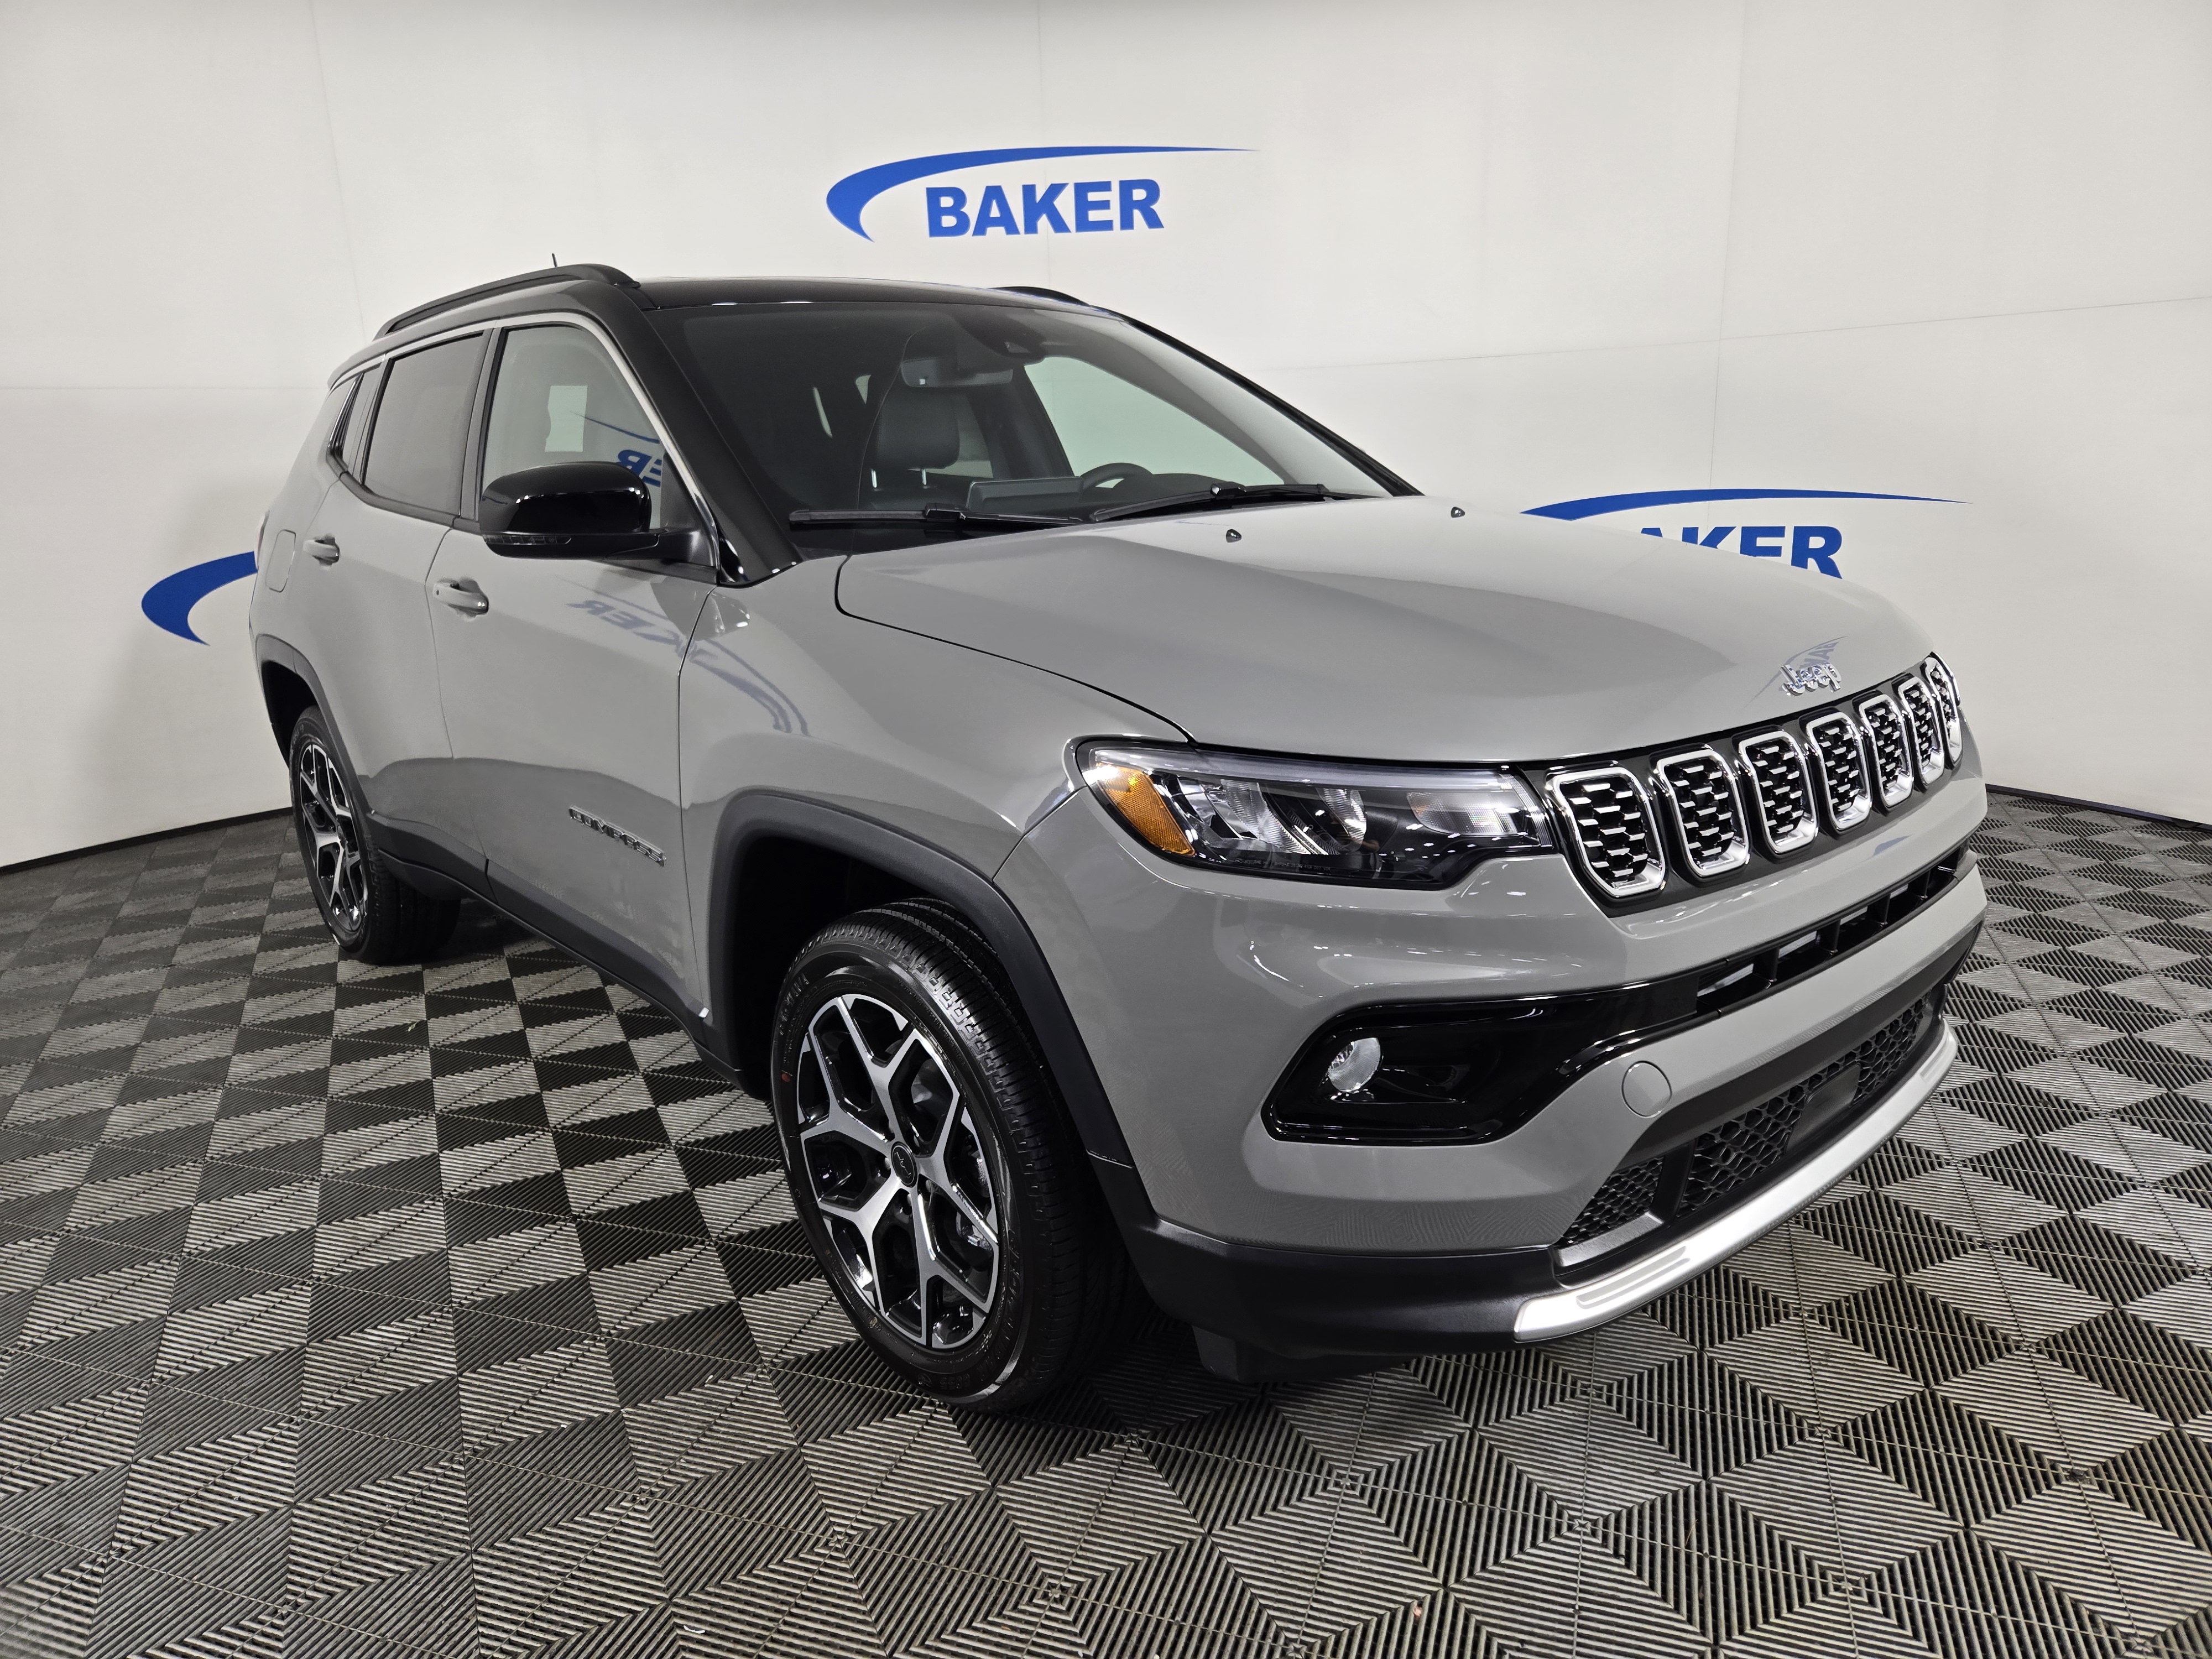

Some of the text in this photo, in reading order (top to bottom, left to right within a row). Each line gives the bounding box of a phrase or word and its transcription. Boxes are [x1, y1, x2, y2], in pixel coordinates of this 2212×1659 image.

[925, 179, 1165, 237] BAKER
[1640, 525, 1843, 580] ER
[1780, 663, 1841, 696] Jeep
